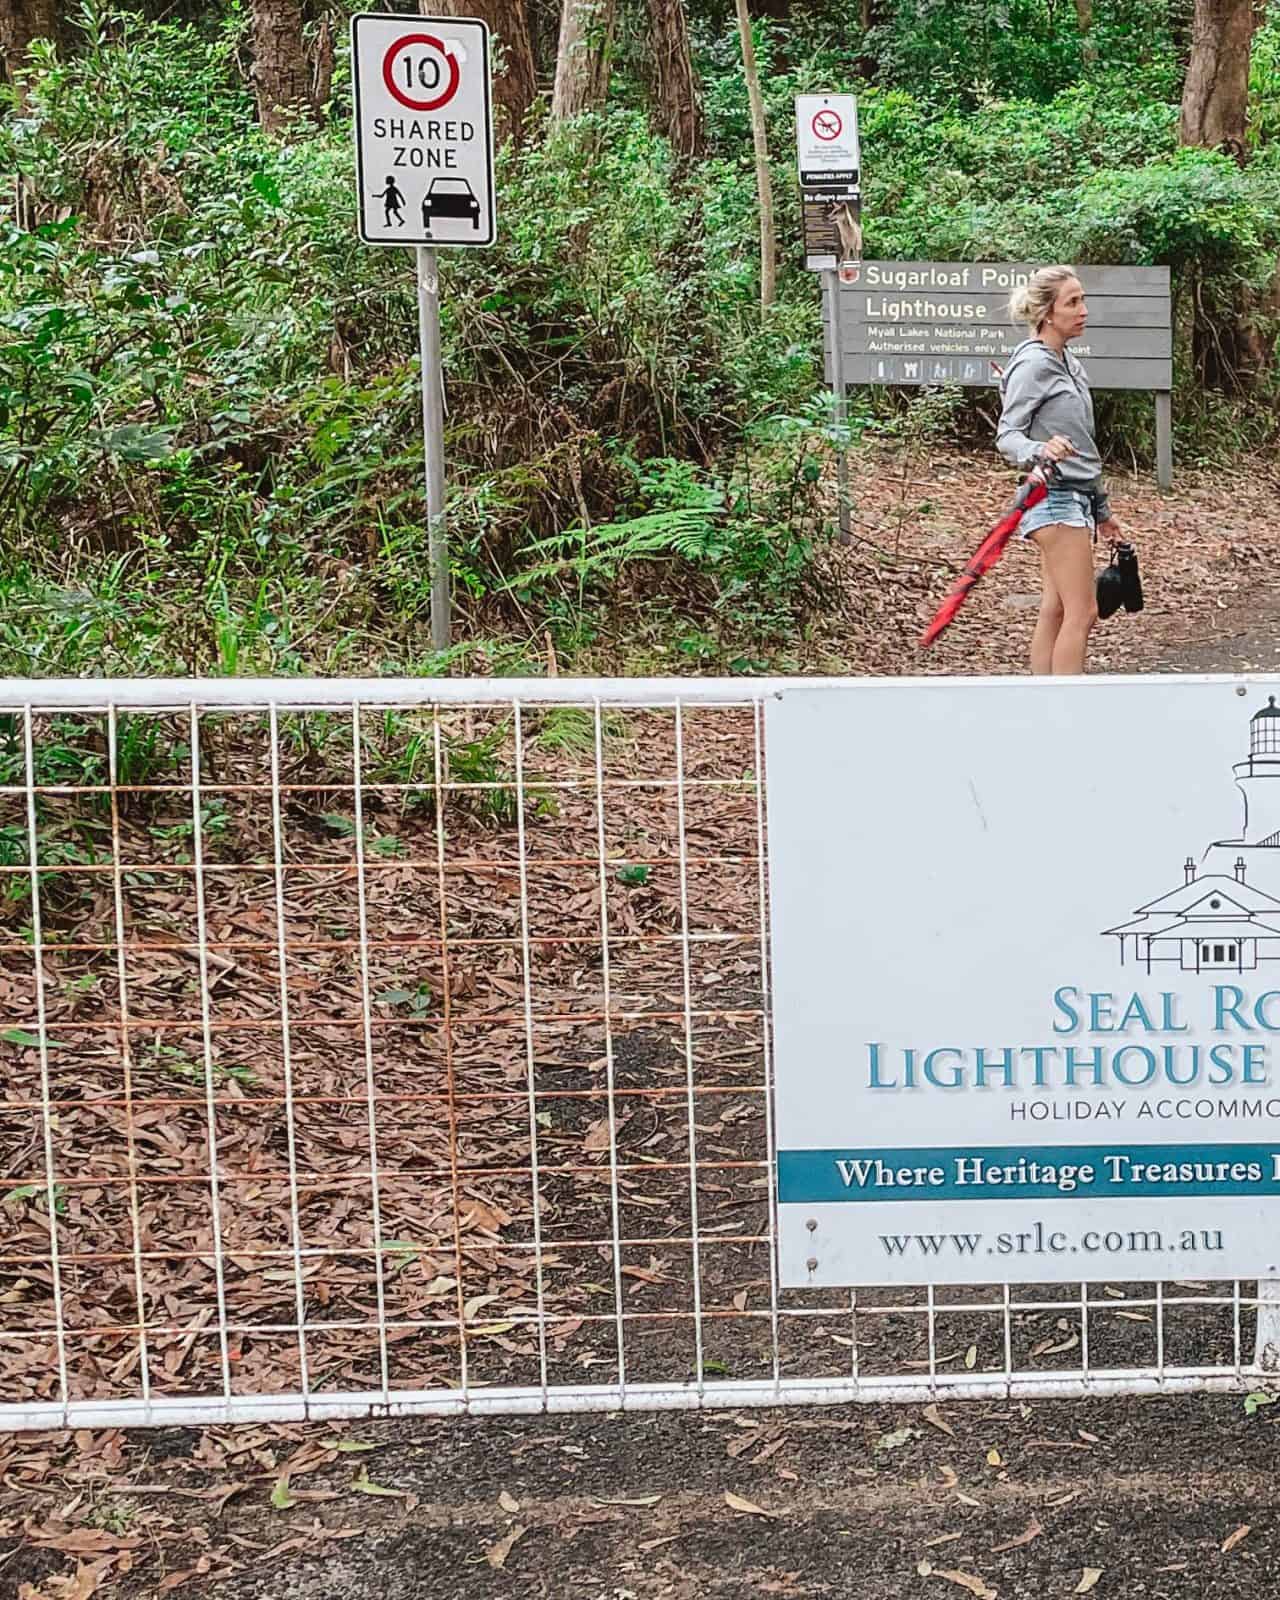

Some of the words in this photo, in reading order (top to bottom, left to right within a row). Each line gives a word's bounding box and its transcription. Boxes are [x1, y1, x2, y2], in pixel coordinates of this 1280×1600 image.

[403, 56, 440, 89] 10
[373, 118, 474, 141] SHARED
[393, 147, 457, 168] ZONE
[866, 266, 970, 290] Sugarloaf
[982, 267, 1035, 288] Poin
[866, 297, 988, 322] Lighthouse
[867, 326, 896, 338] Myall
[899, 327, 930, 337] Lakes
[934, 328, 976, 338] National
[980, 329, 1005, 339] Park
[868, 341, 925, 352] Authorised
[930, 342, 970, 353] vehicles
[974, 343, 996, 354] only
[1010, 1101, 1127, 1121] HOLIDAY
[835, 1159, 945, 1188] Where
[953, 1157, 1094, 1191] Heritage
[1103, 1155, 1264, 1183] Treasures
[878, 1221, 1225, 1256] www.srlc.com.au
